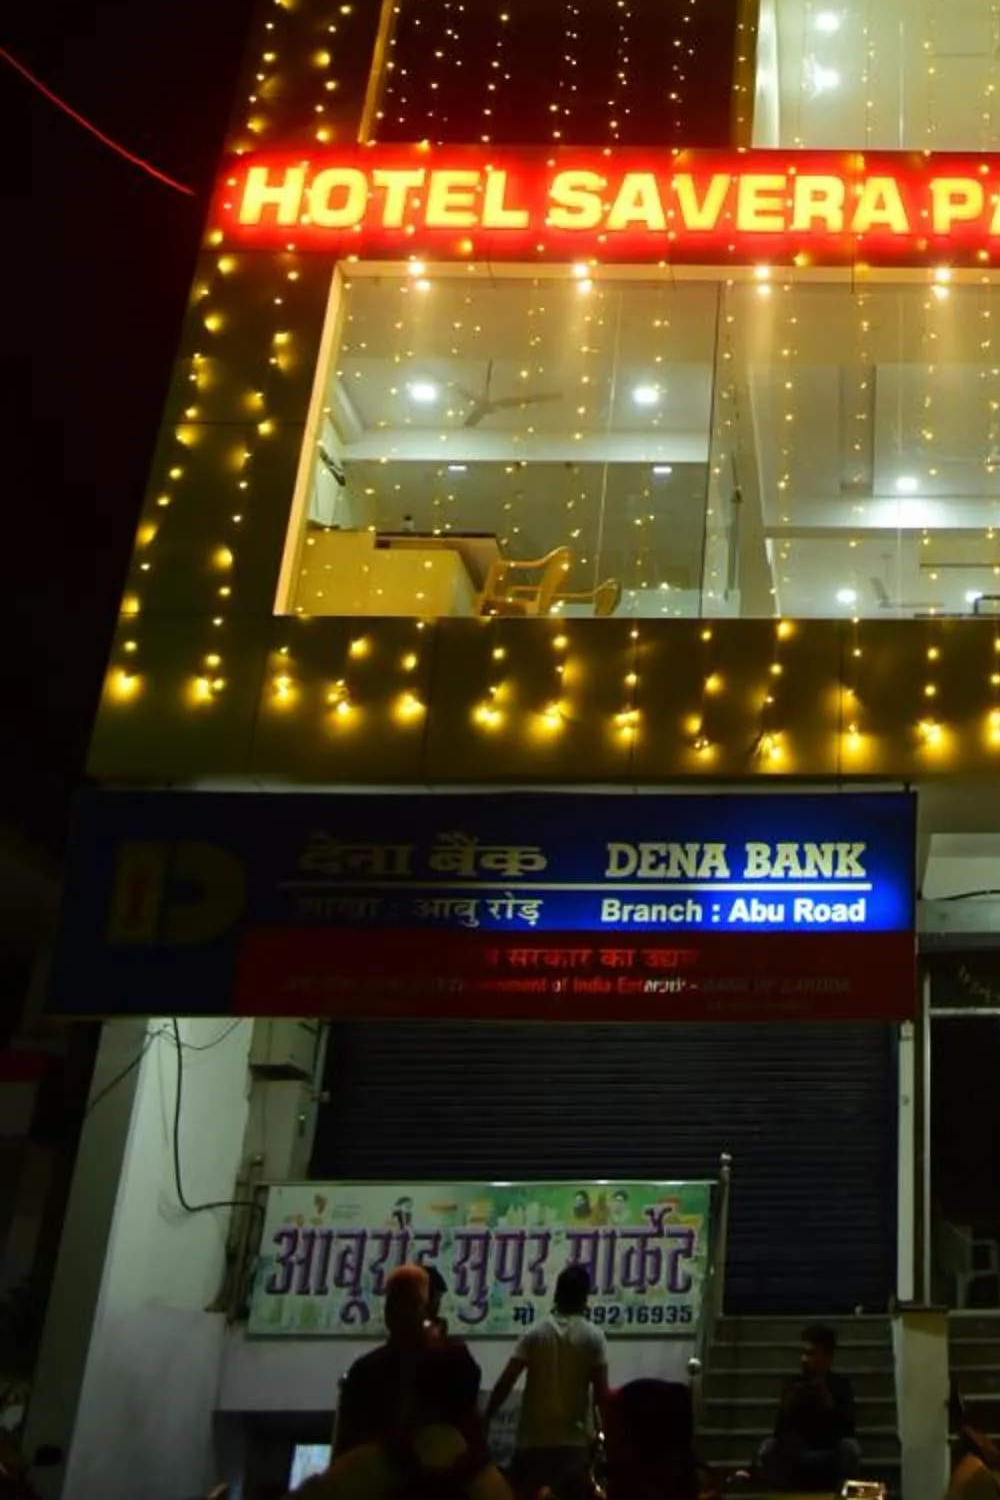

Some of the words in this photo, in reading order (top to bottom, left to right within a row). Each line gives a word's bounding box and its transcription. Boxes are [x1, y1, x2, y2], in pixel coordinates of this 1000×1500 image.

[239, 166, 529, 229] HOTEL
[549, 170, 911, 236] SAVERA
[605, 841, 731, 879] DENA
[743, 841, 868, 879] BANK
[600, 897, 703, 923] Branch
[728, 897, 785, 923] Abu
[793, 897, 867, 923] Road
[453, 1228, 551, 1324] सुपर
